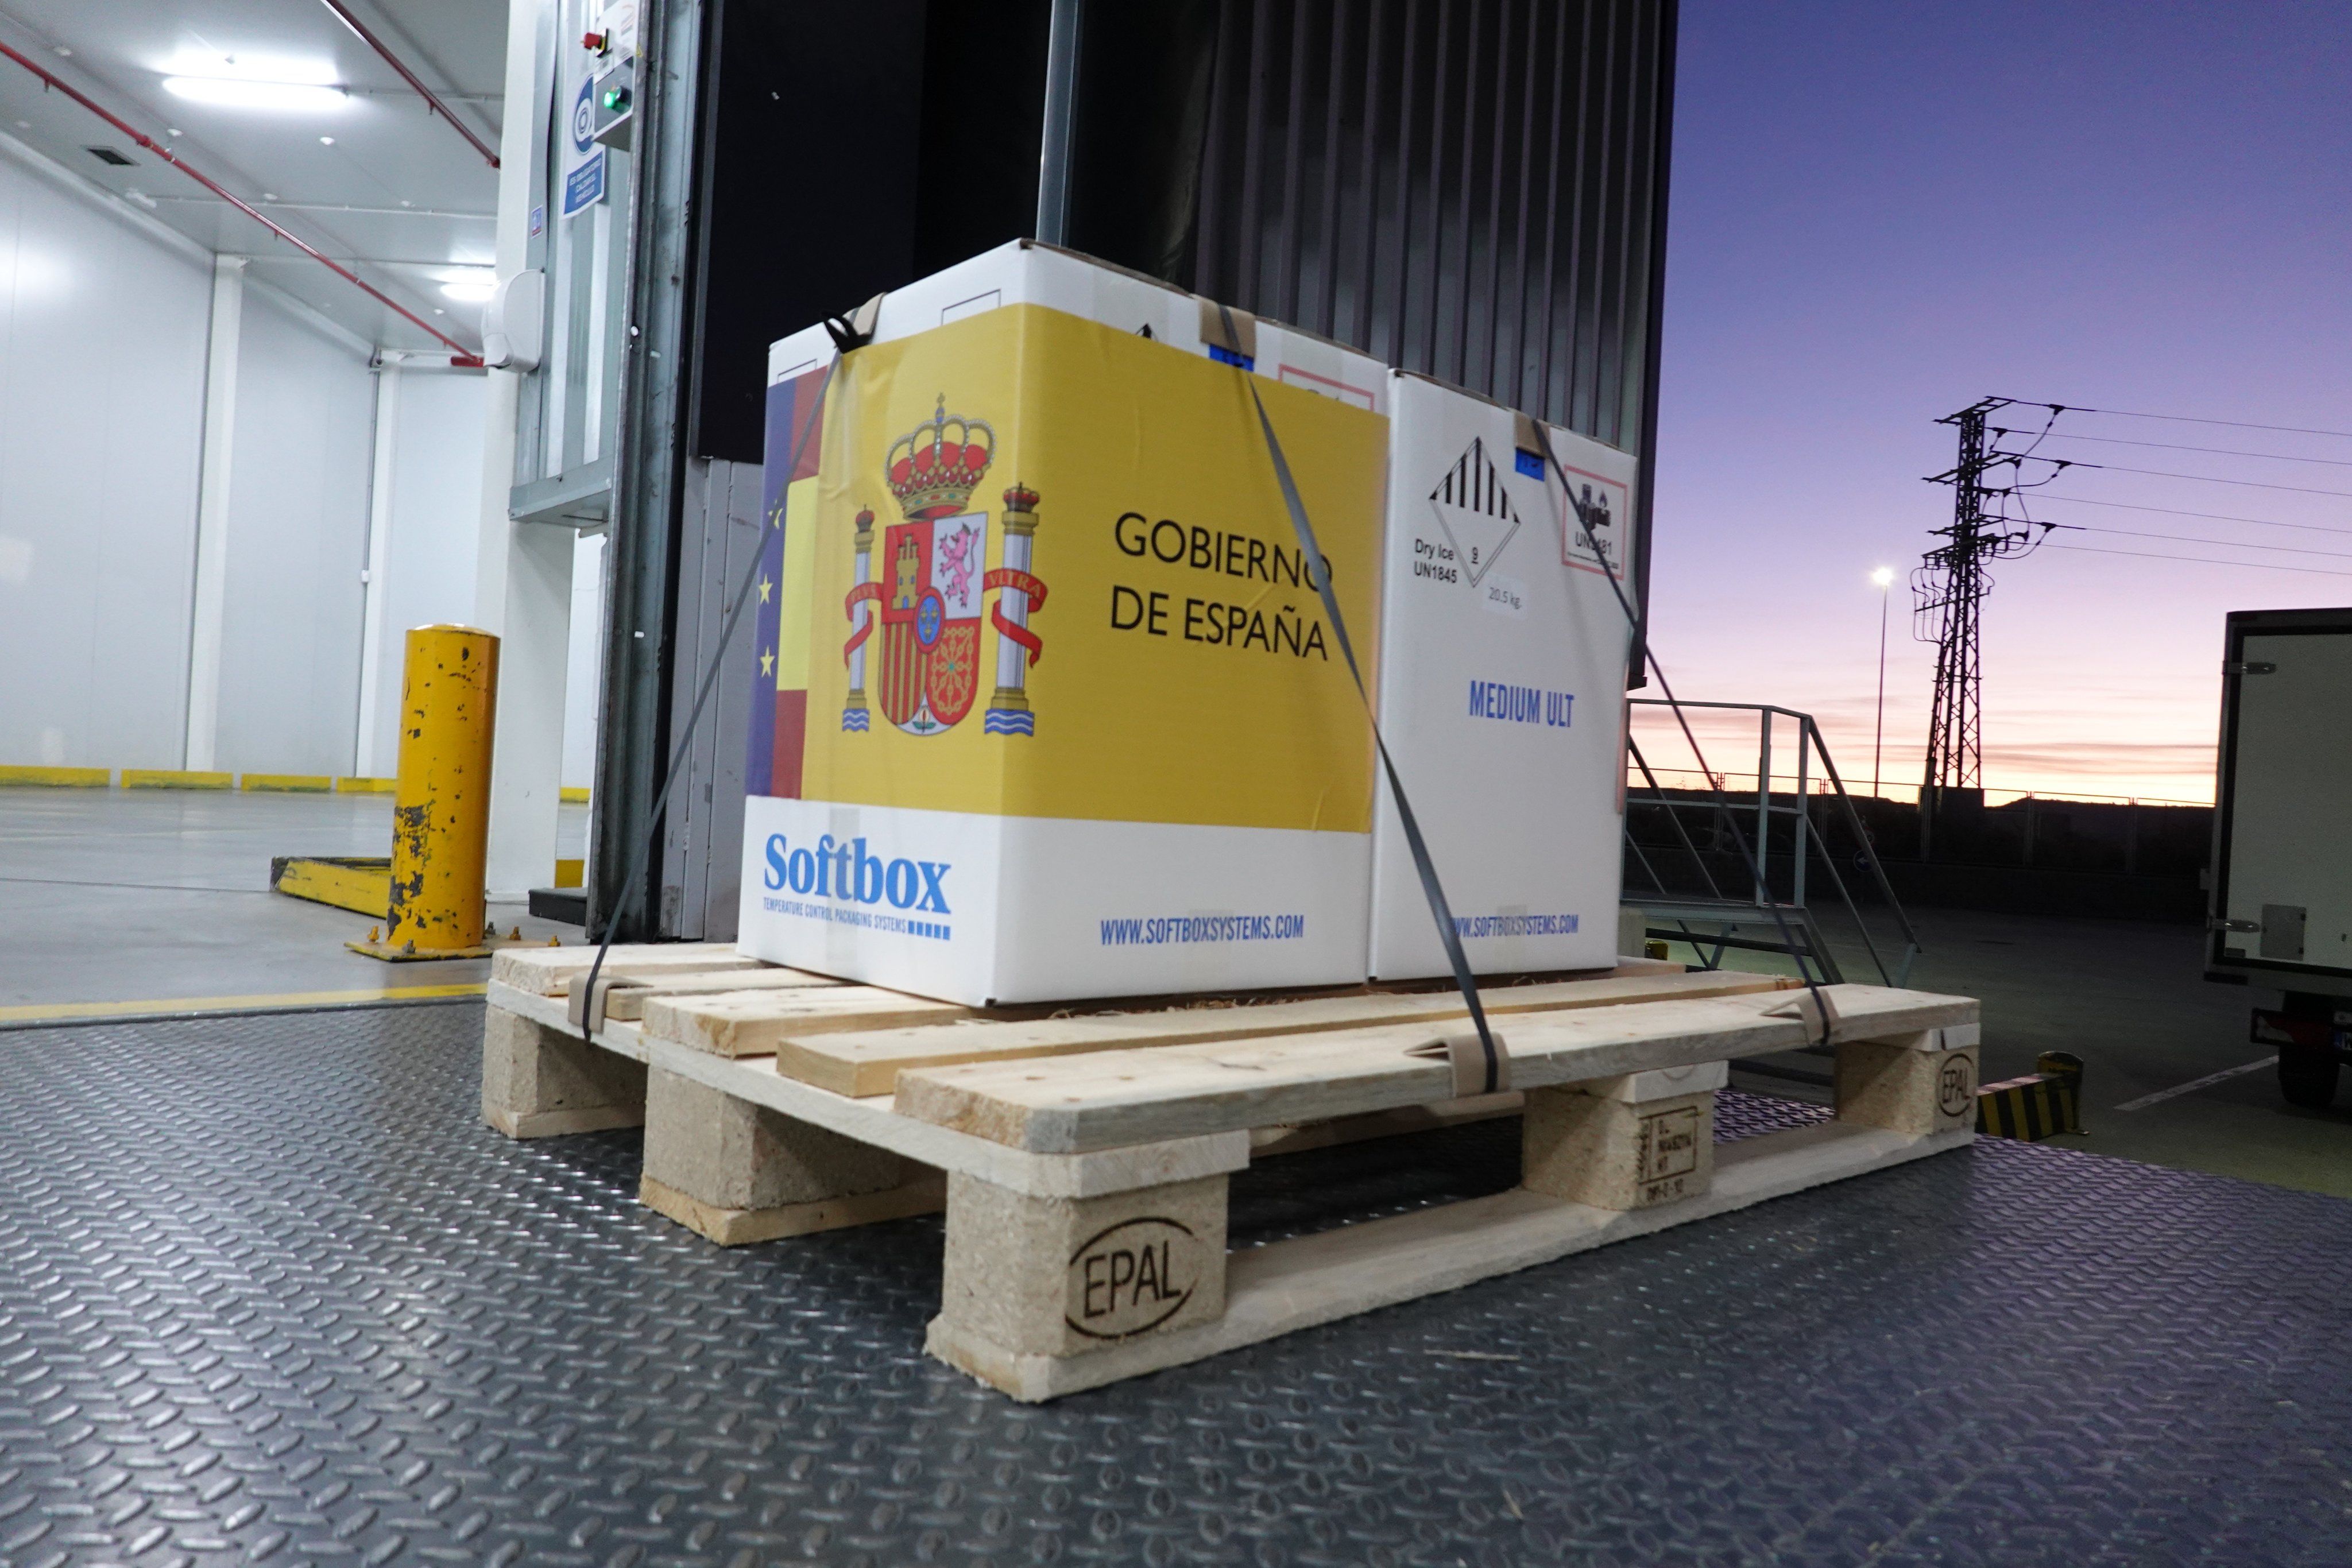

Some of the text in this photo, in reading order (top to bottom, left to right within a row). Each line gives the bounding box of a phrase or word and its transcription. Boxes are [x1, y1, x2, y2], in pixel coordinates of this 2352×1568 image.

[1115, 512, 1333, 592] GOBIERNO
[1415, 538, 1454, 560] Dry Ice
[1414, 561, 1457, 583] UN1845
[1489, 587, 1508, 603] 20.5
[1111, 585, 1328, 661] DE ESPAÑA
[1468, 679, 1575, 727] MEDIUM ULT
[764, 833, 951, 915] Softbox
[763, 897, 907, 934] TEMPERATURE CONTROL PACKAGING SYSTEMS
[1101, 915, 1304, 945] WWW.SOFTBOXSYSTEMS.COM
[1942, 1067, 1971, 1104] EPAL
[1084, 1240, 1182, 1319] EPAL
